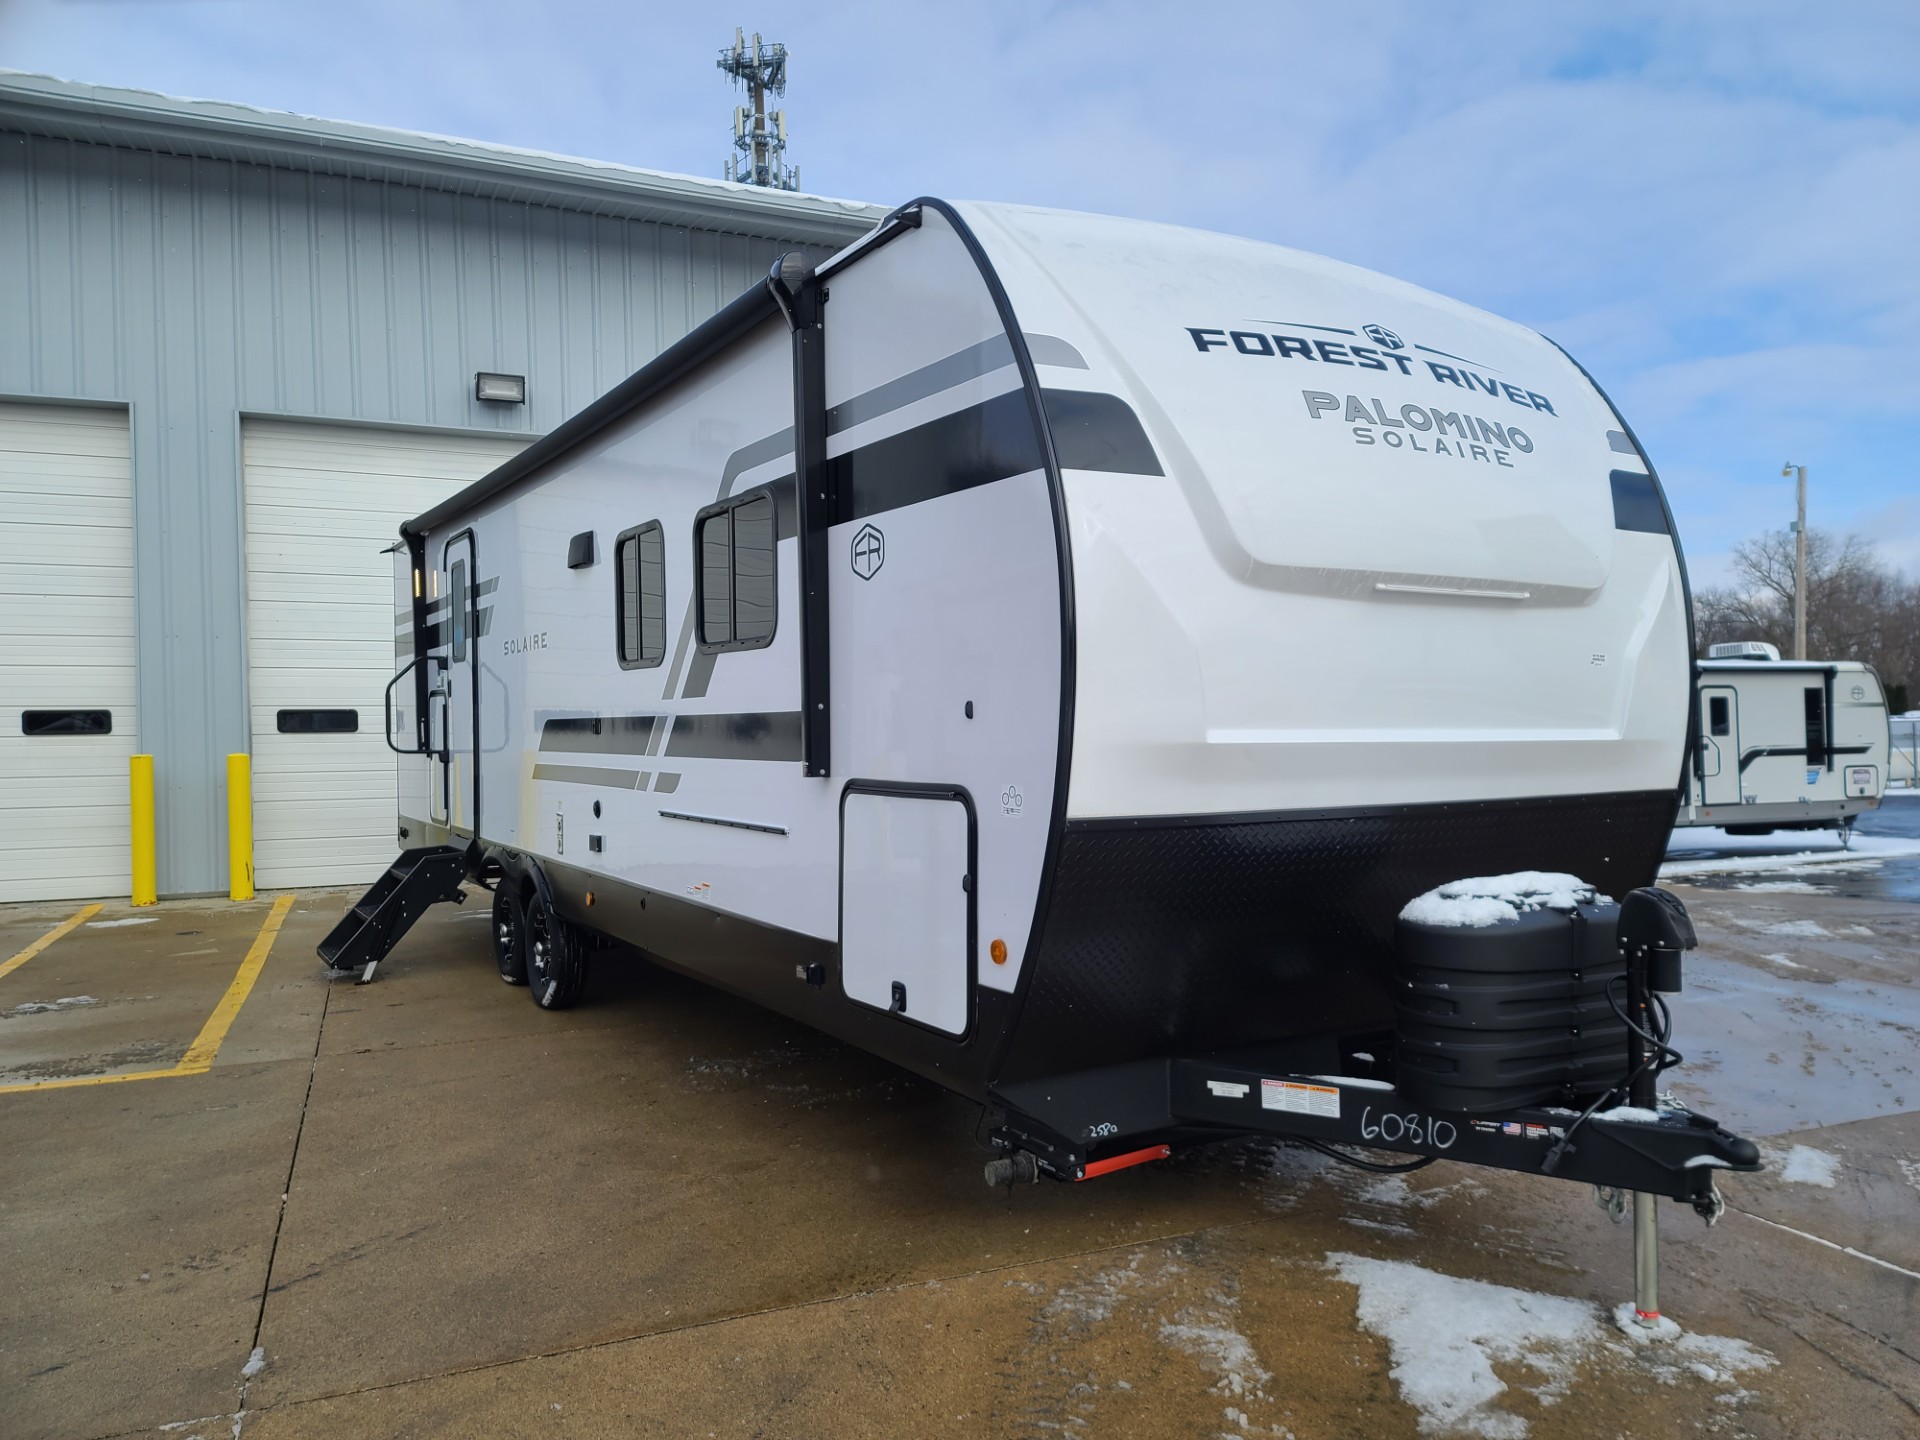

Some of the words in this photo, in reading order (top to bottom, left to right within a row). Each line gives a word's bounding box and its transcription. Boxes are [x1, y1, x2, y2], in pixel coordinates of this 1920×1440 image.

[1184, 327, 1413, 376] FOREST
[1423, 359, 1560, 418] RIVER
[1301, 389, 1534, 454] PALOMINO
[1351, 426, 1515, 468] SOLAIRE
[503, 631, 548, 656] SOLAIRE
[1361, 1106, 1457, 1149] 60810
